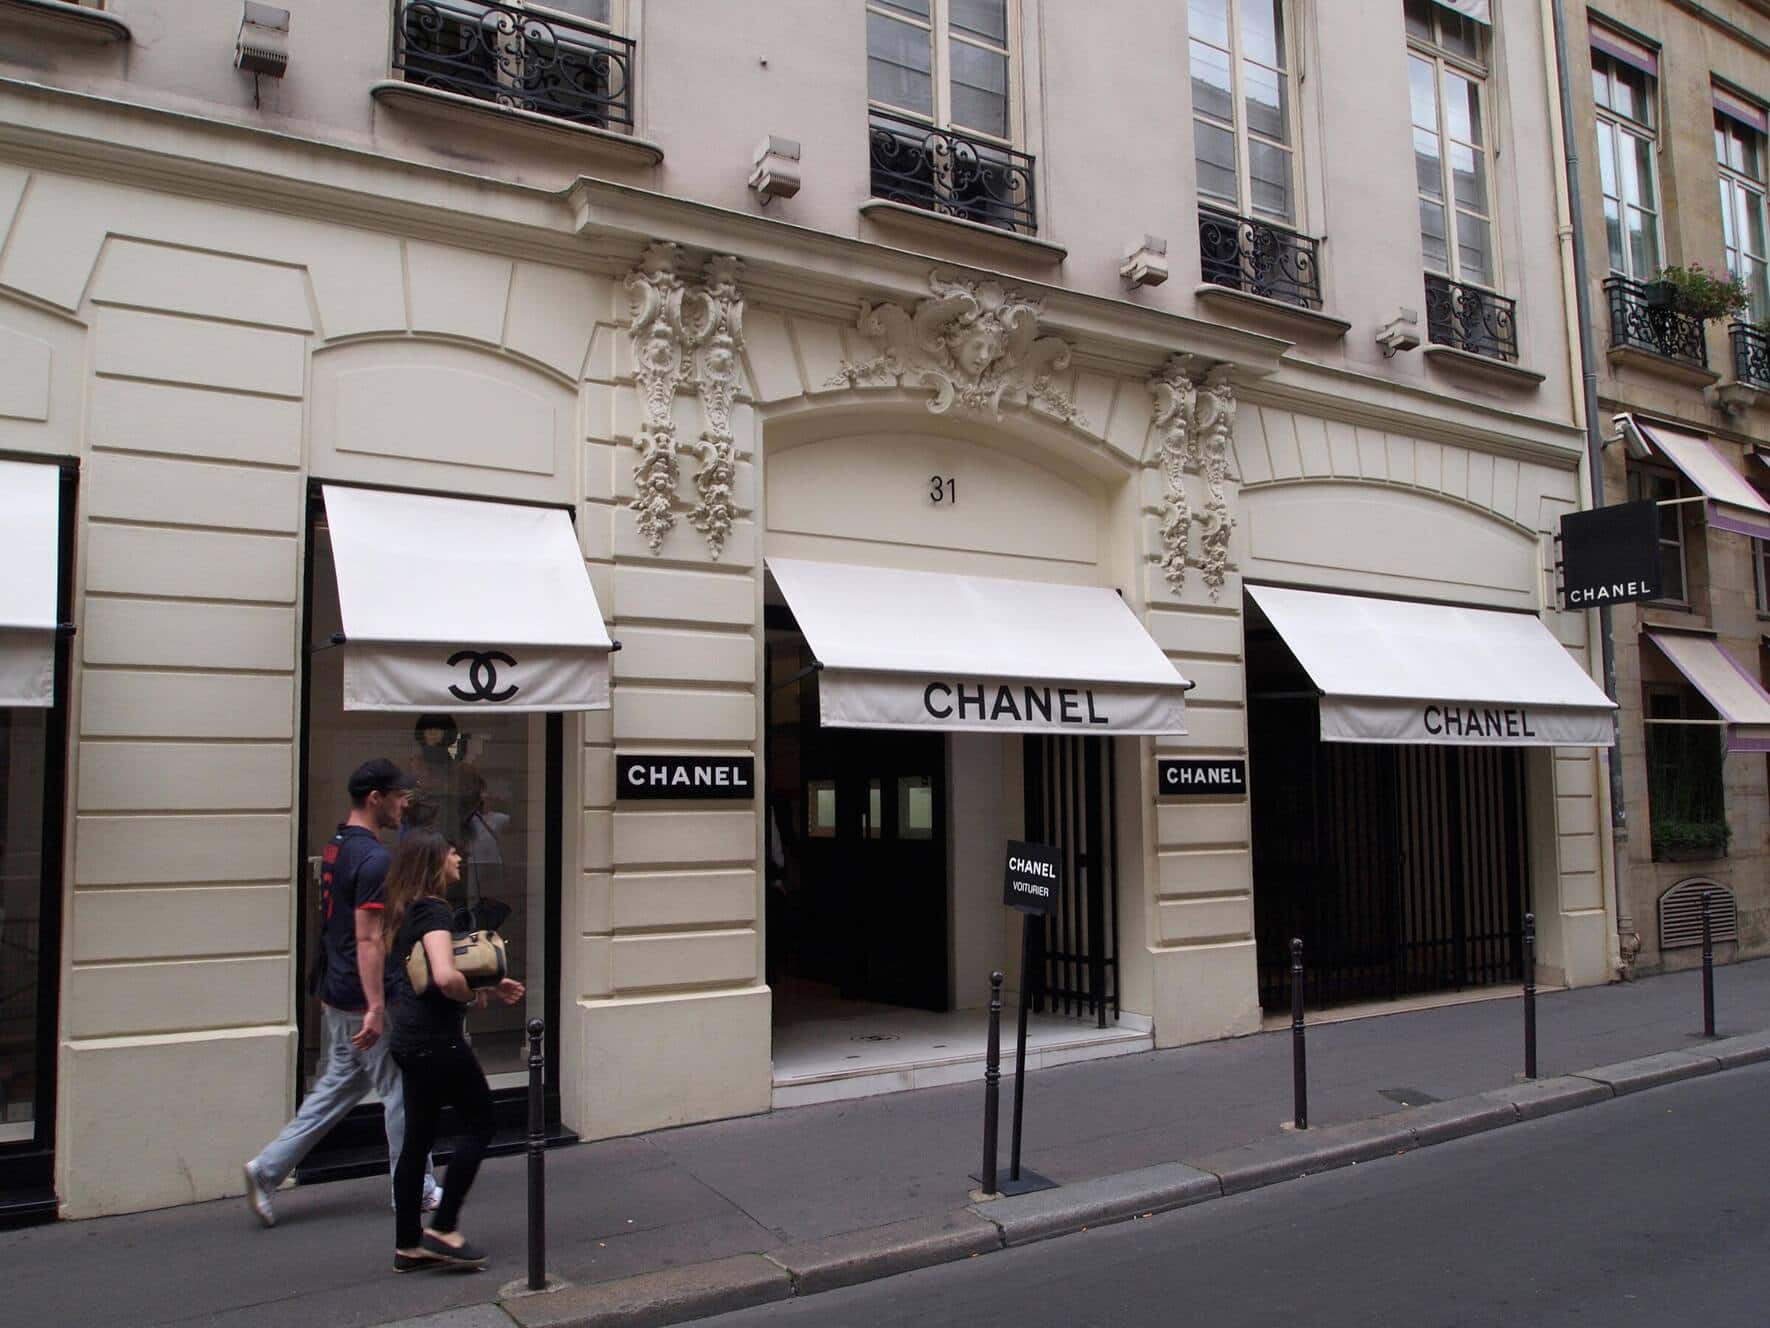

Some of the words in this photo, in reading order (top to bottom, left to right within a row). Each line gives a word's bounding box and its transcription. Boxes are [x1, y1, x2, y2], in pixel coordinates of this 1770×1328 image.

[930, 475, 955, 504] 31
[1570, 581, 1651, 602] CHANEL
[924, 682, 1109, 724] CHANEL
[1423, 705, 1536, 737] CHANEL
[628, 765, 747, 786] CHANEL
[1166, 767, 1242, 784] CHANEL
[1008, 857, 1056, 879] CHANEL
[1012, 881, 1049, 897] VOITURIER
